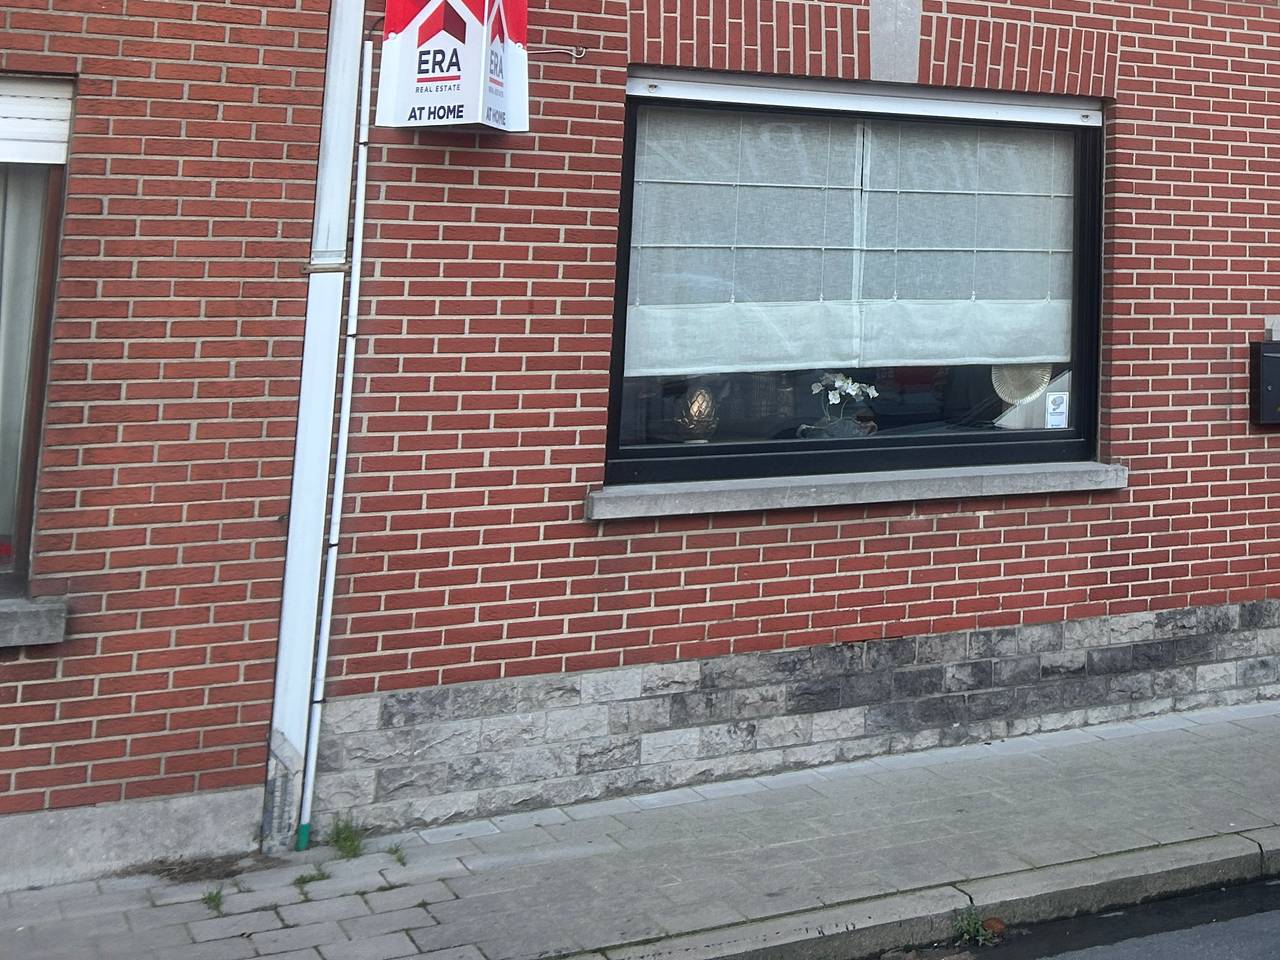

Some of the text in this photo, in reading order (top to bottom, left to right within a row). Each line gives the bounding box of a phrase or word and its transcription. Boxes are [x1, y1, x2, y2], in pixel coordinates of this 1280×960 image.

[417, 48, 461, 75] ERA
[489, 49, 504, 79] ERA
[416, 84, 461, 94] REAL ESTATE
[408, 104, 464, 121] AT HOME
